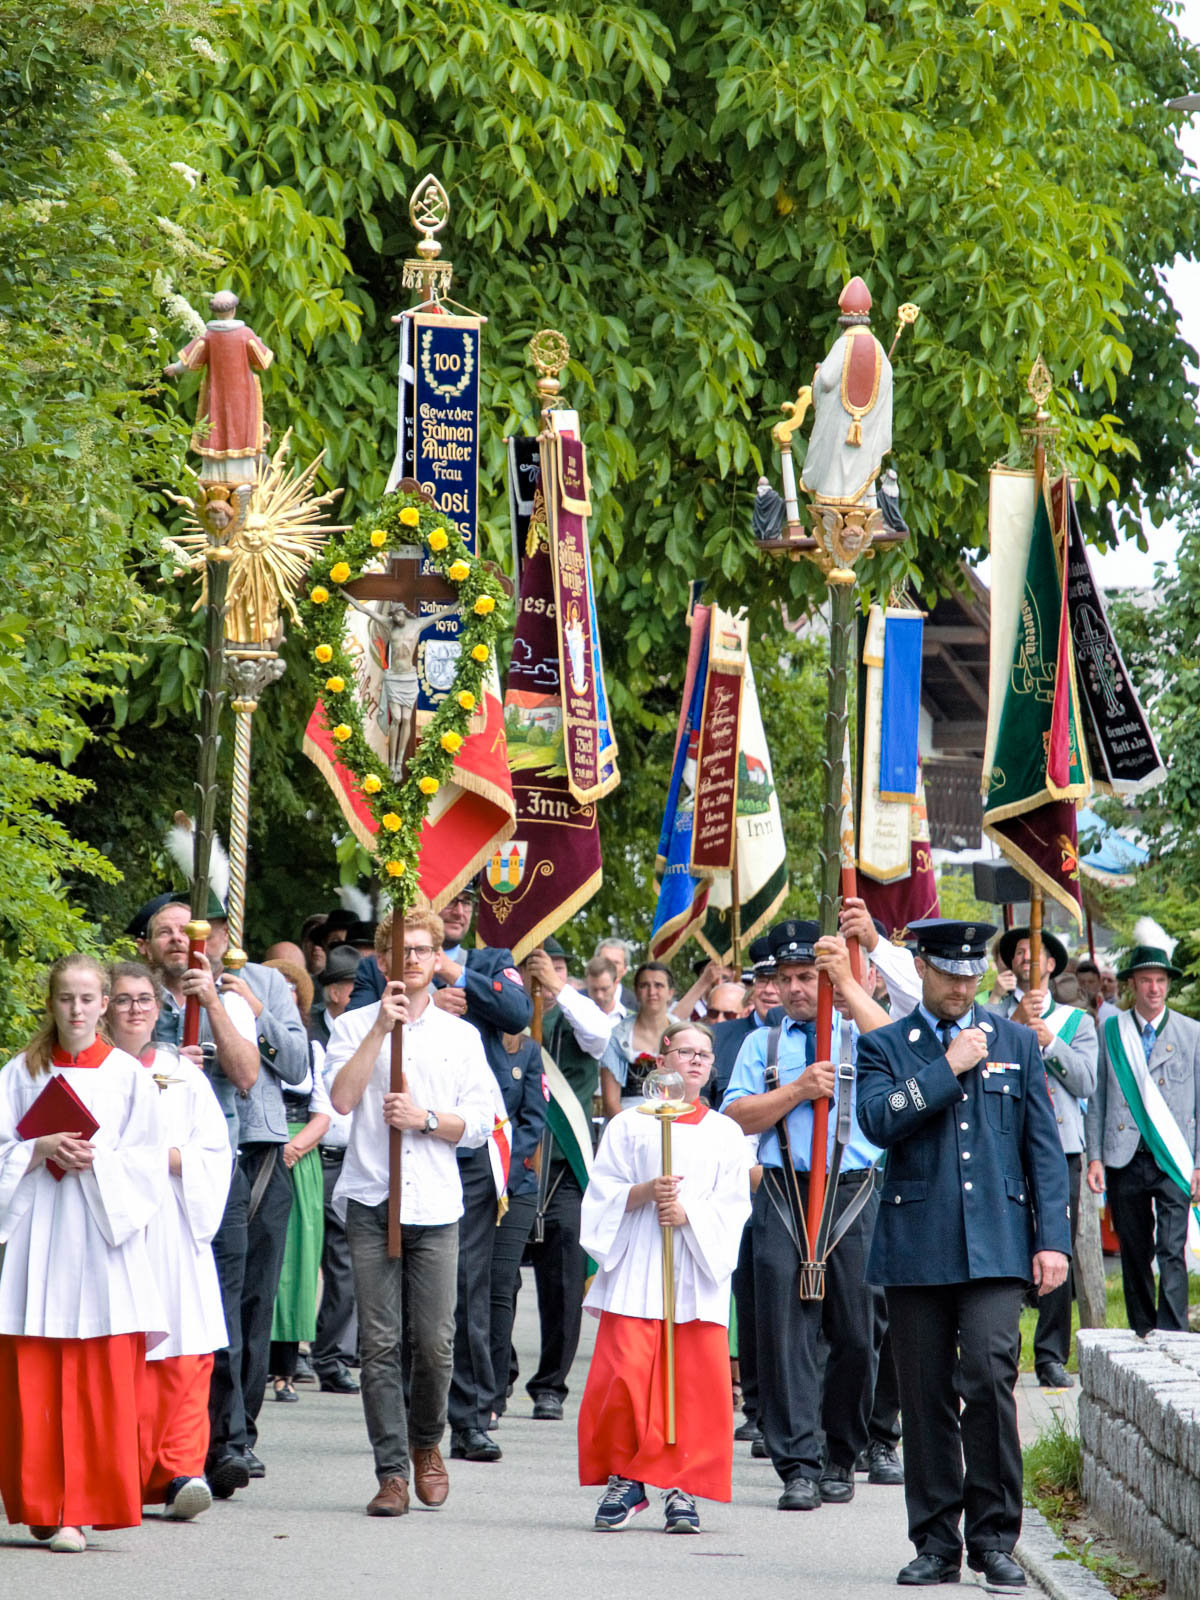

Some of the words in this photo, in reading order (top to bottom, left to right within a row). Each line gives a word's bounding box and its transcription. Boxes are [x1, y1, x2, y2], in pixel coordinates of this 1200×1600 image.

[433, 353, 461, 372] 100
[421, 419, 473, 442] Fahnen
[421, 438, 472, 461] Mutter
[432, 460, 463, 481] Frau
[435, 620, 458, 633] 1970
[526, 791, 569, 819] Inn
